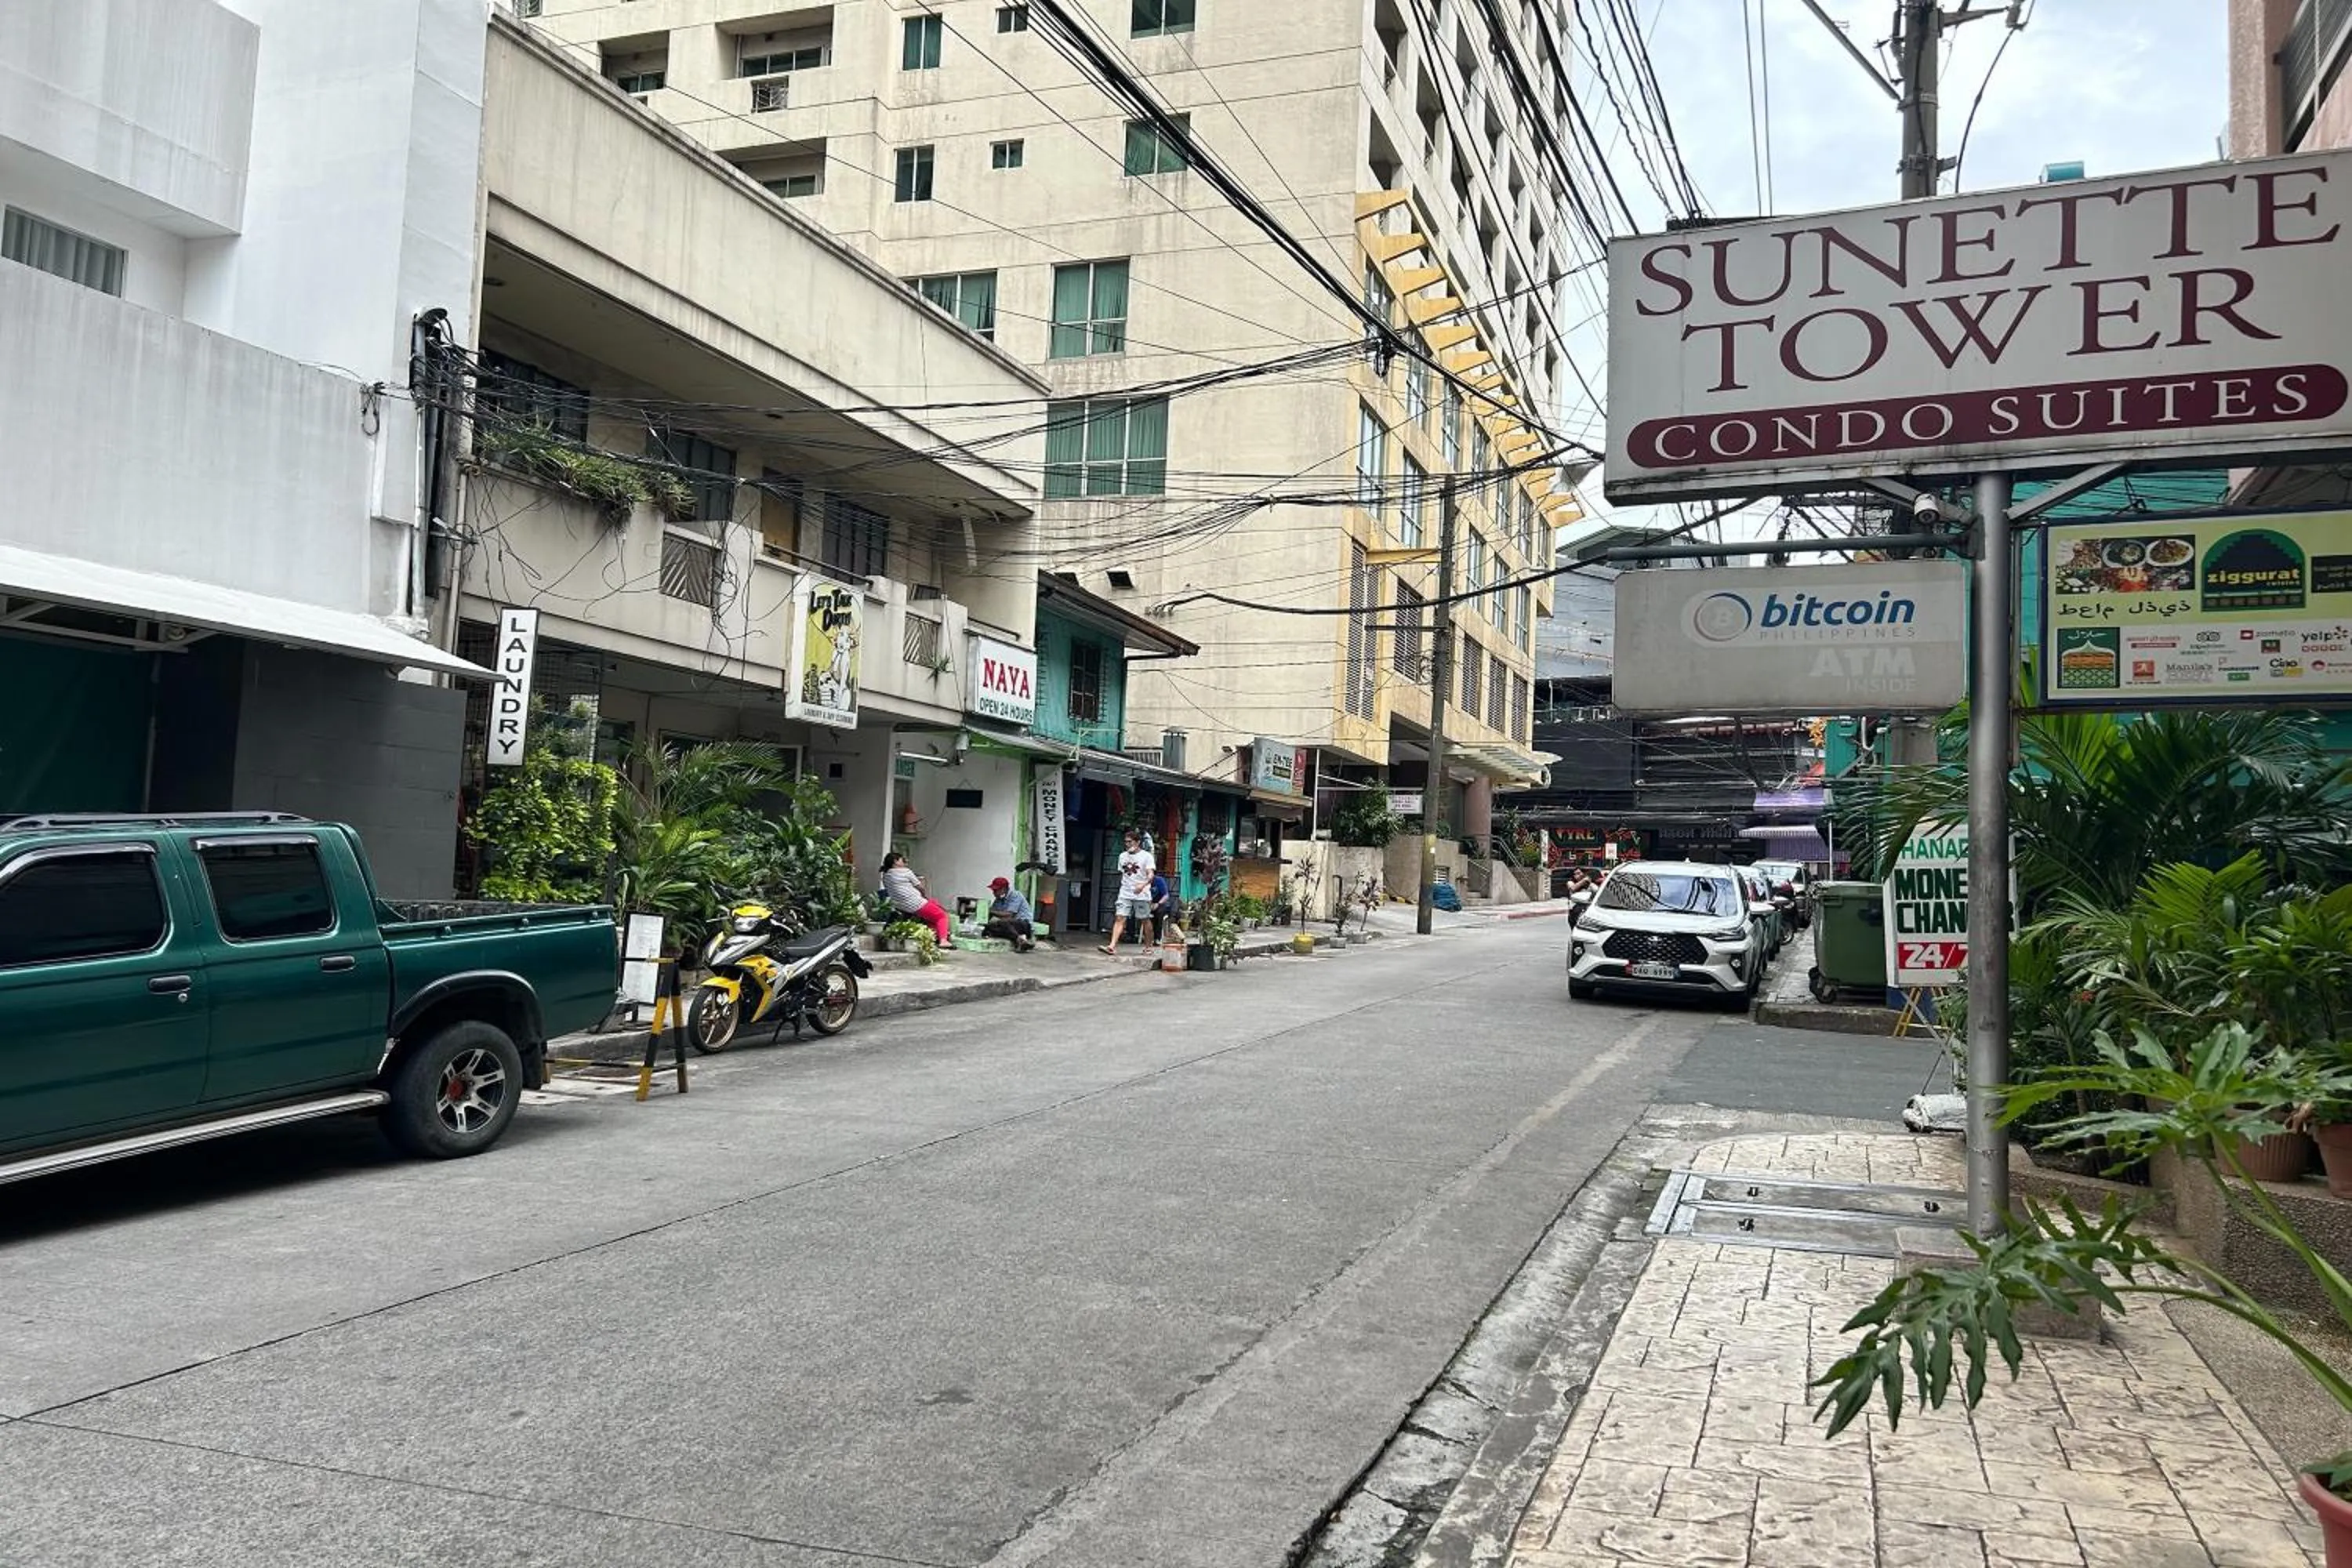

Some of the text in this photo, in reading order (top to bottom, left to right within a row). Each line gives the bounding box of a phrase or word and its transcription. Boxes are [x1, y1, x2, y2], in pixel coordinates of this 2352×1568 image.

[1635, 167, 2341, 316] SUNETTE
[1681, 268, 2282, 393] TOWER
[1654, 373, 2310, 461] CONDO SUITES
[2207, 568, 2300, 585] ziggurat
[1761, 590, 1915, 628] bitcoin
[1760, 627, 1916, 640] PHILIPPINES
[2301, 630, 2333, 643] yelp
[1809, 646, 1916, 677] ATM
[498, 618, 528, 754] LAUNDRY
[983, 658, 1031, 699] NAYA
[1846, 678, 1918, 692] INSIDE
[979, 697, 1033, 723] OPEN 24 HOURS
[1042, 789, 1058, 822] MONEY
[1044, 826, 1059, 872] CHANGE
[1894, 868, 1969, 900] MONE
